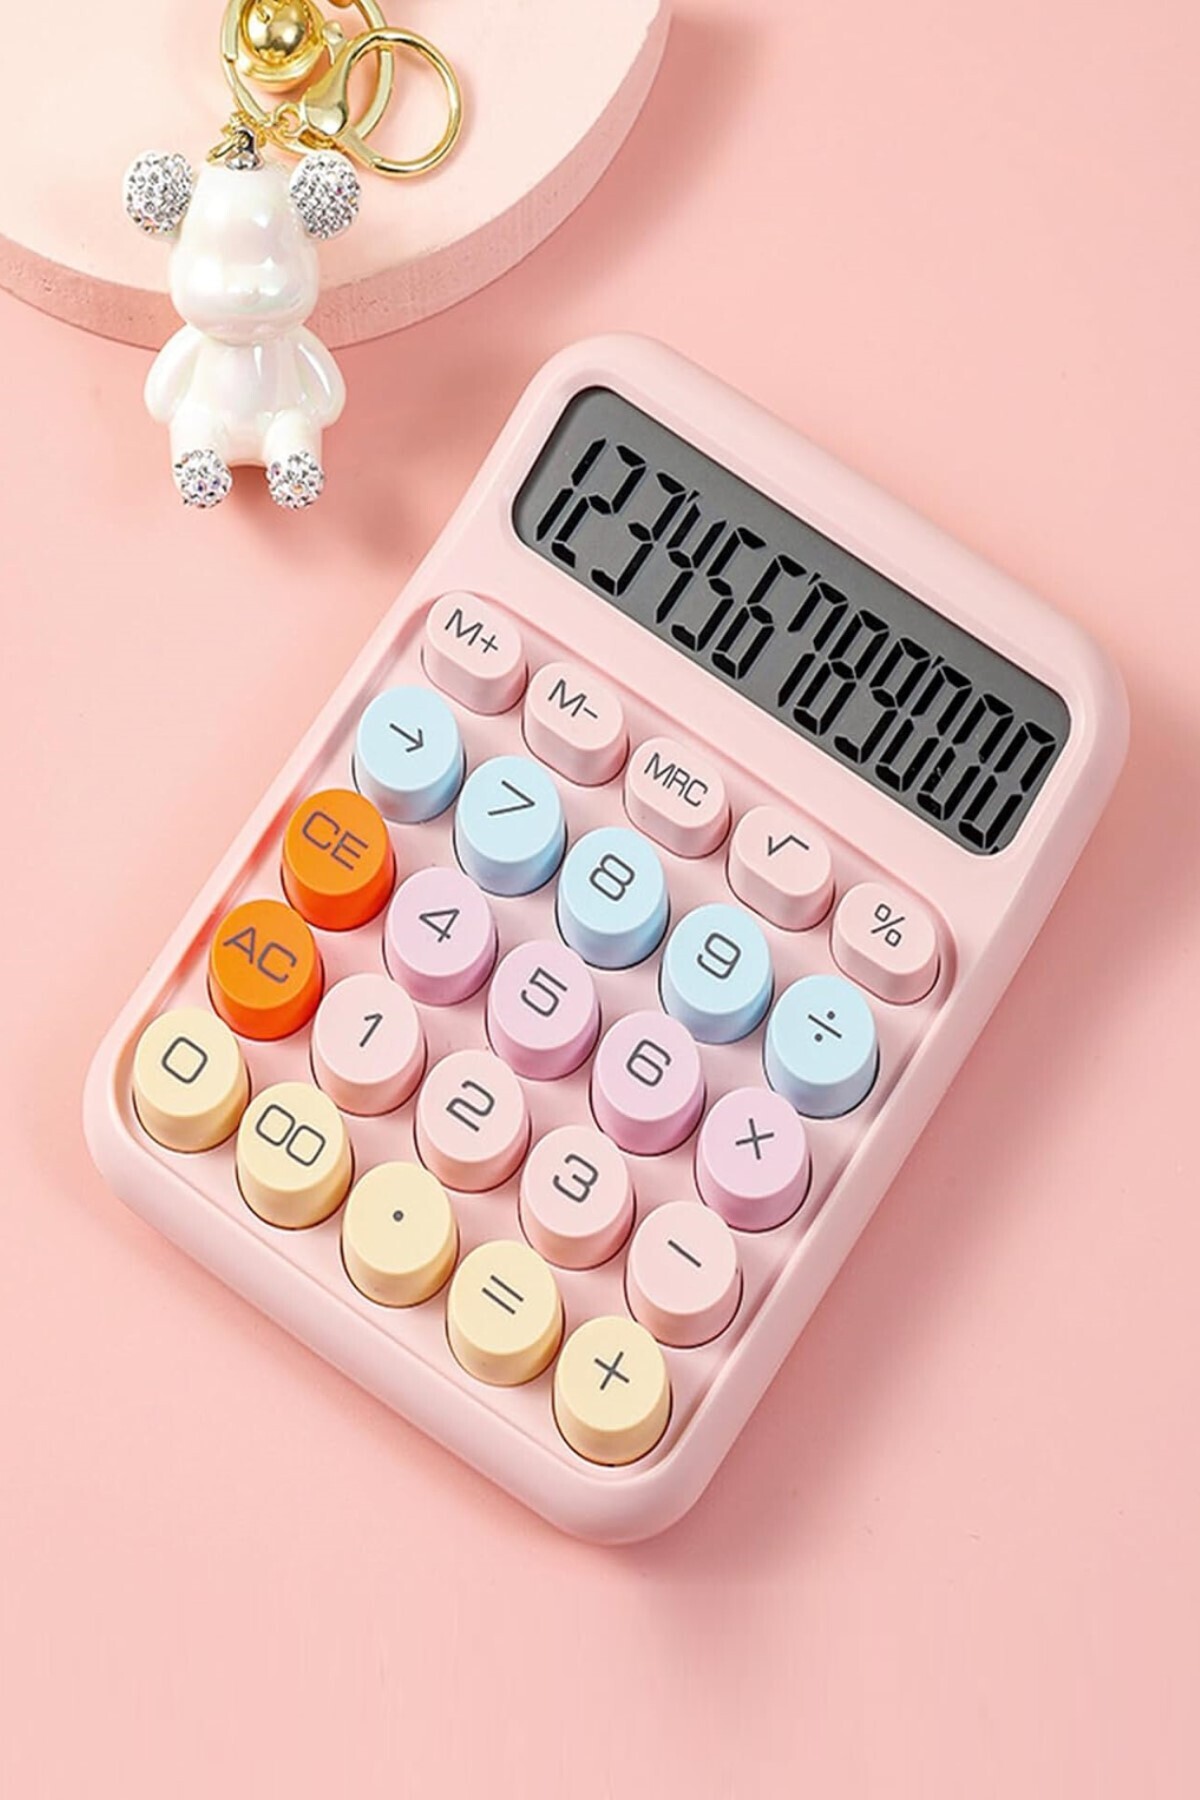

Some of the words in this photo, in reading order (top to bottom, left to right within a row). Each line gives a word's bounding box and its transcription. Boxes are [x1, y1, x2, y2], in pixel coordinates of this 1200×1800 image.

[444, 608, 499, 654] M+
[547, 678, 598, 719] M-
[487, 780, 536, 817] 7
[643, 752, 709, 808] MRC
[301, 811, 369, 870] CE
[589, 853, 636, 902] 8
[418, 908, 460, 943] 4
[870, 903, 906, 948] %
[223, 926, 298, 984] AC
[696, 932, 742, 980] 9
[520, 967, 568, 1018] 5
[359, 1013, 383, 1048] 1
[161, 1036, 208, 1085] 0
[625, 1039, 672, 1087] 6
[445, 1080, 495, 1132] 2
[255, 1103, 327, 1167] 00
[552, 1153, 599, 1203] 3
